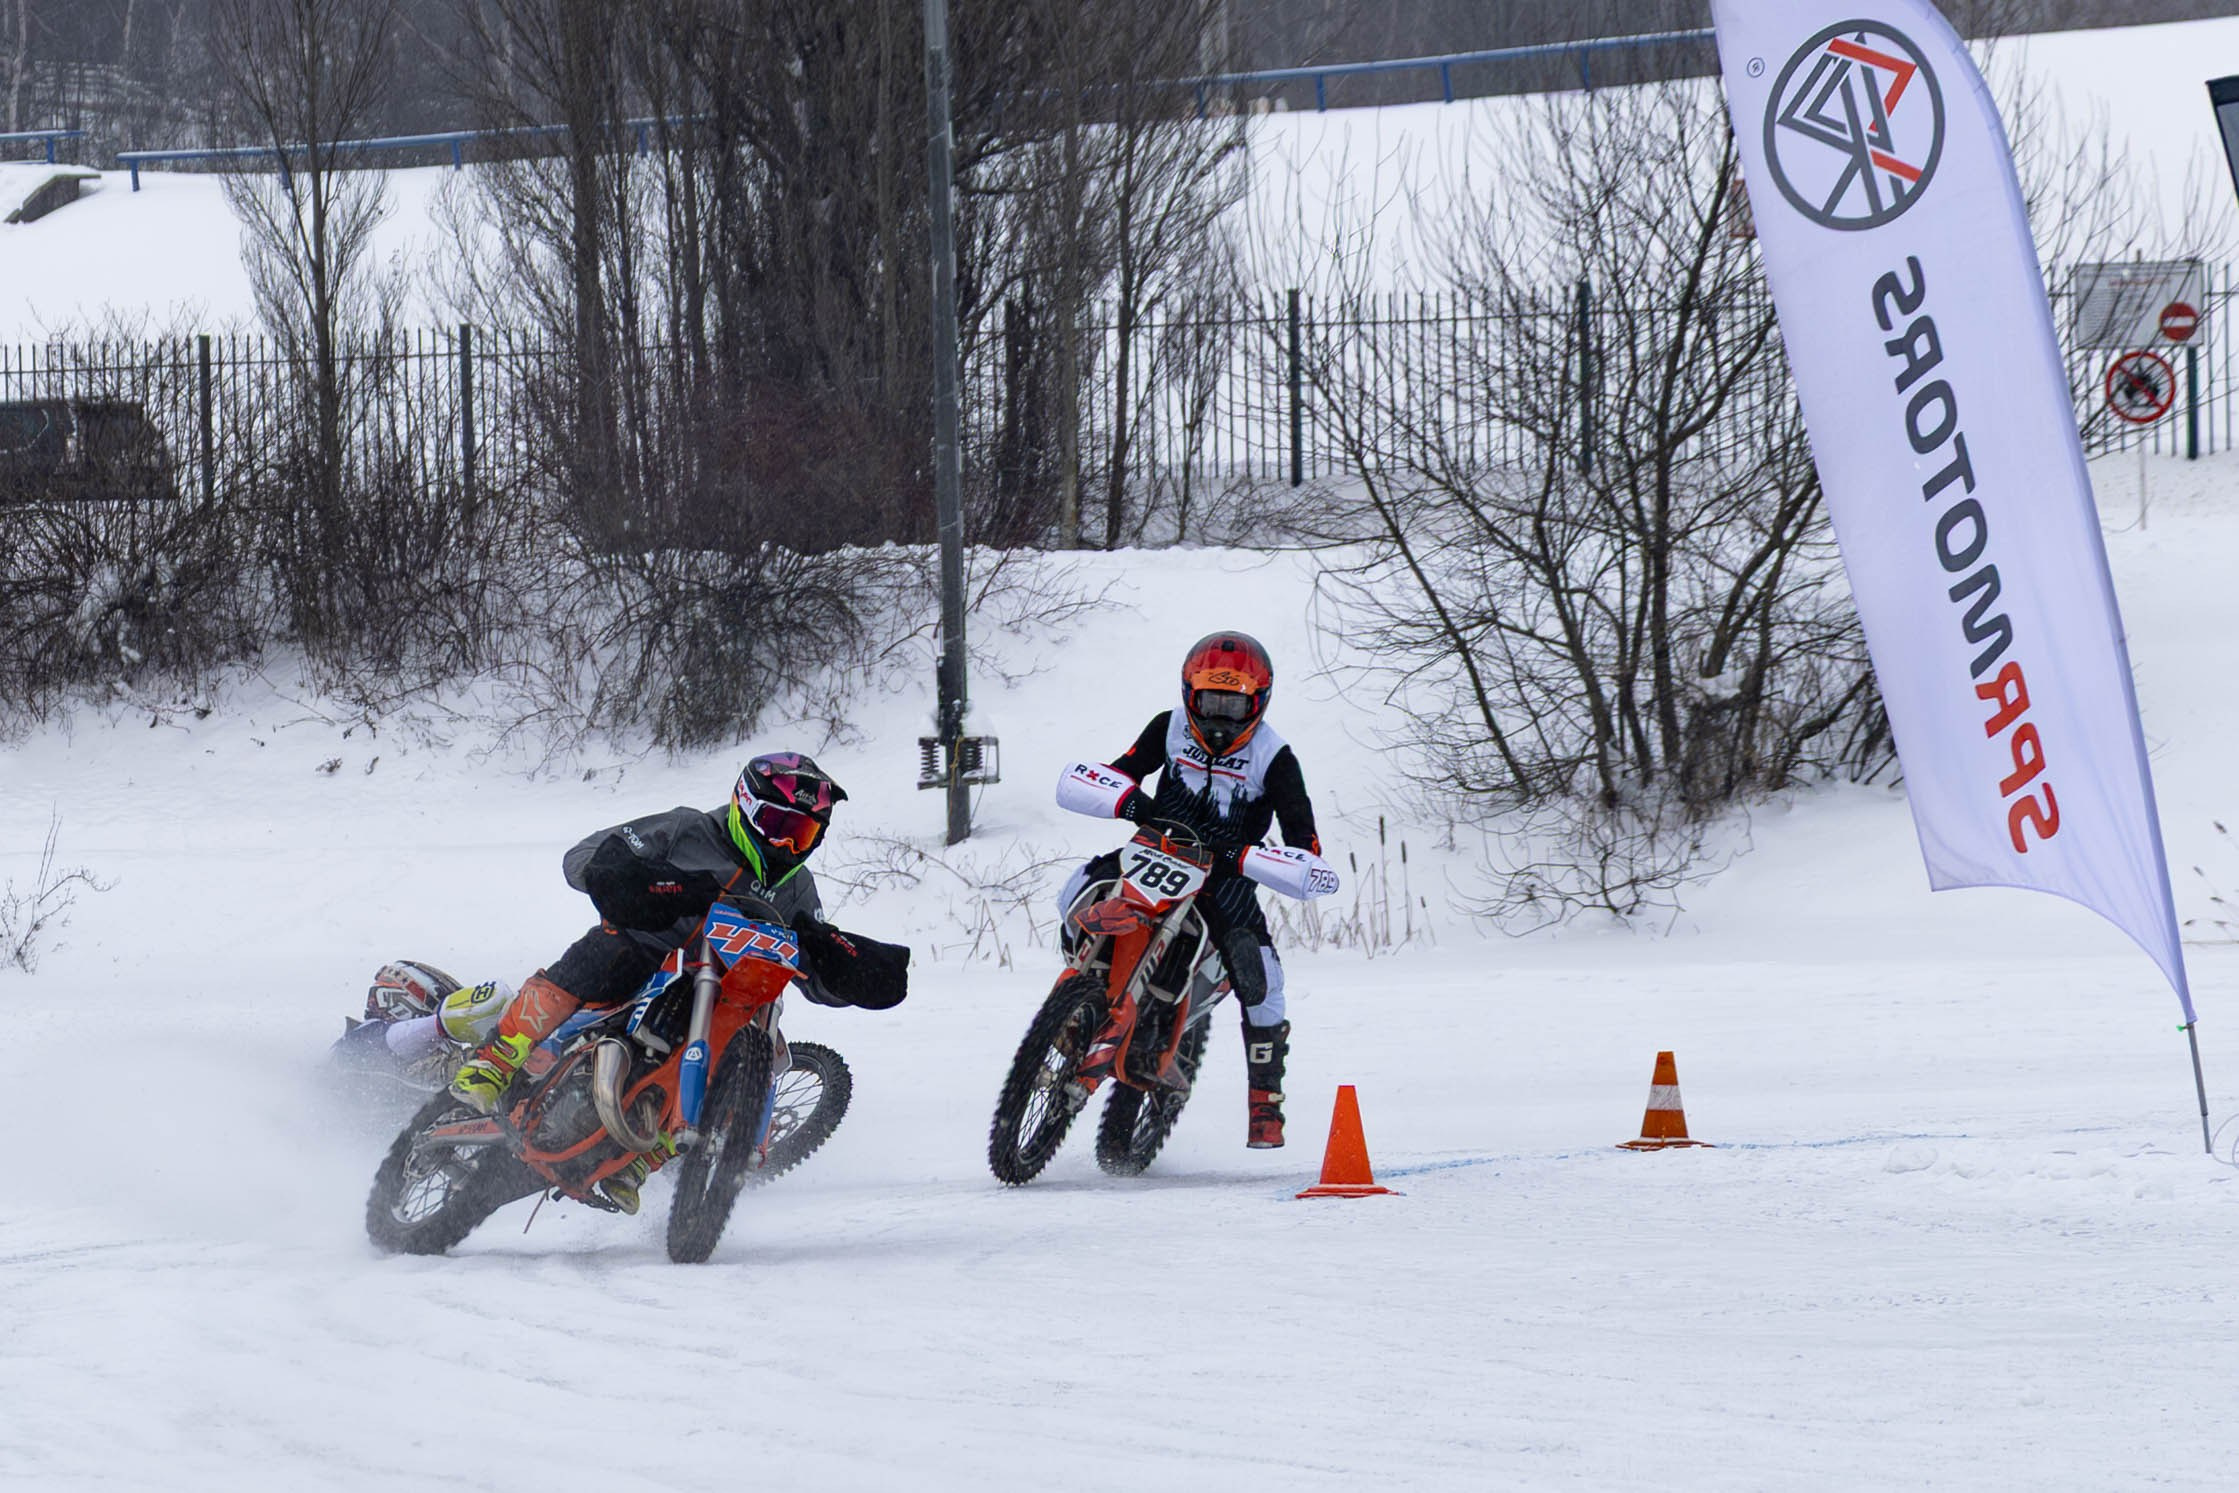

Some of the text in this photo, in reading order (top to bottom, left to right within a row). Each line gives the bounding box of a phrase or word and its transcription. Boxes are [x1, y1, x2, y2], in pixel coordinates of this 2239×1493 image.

[1122, 853, 1191, 897] 789
[1308, 868, 1340, 895] 789
[1250, 1042, 1273, 1064] G
